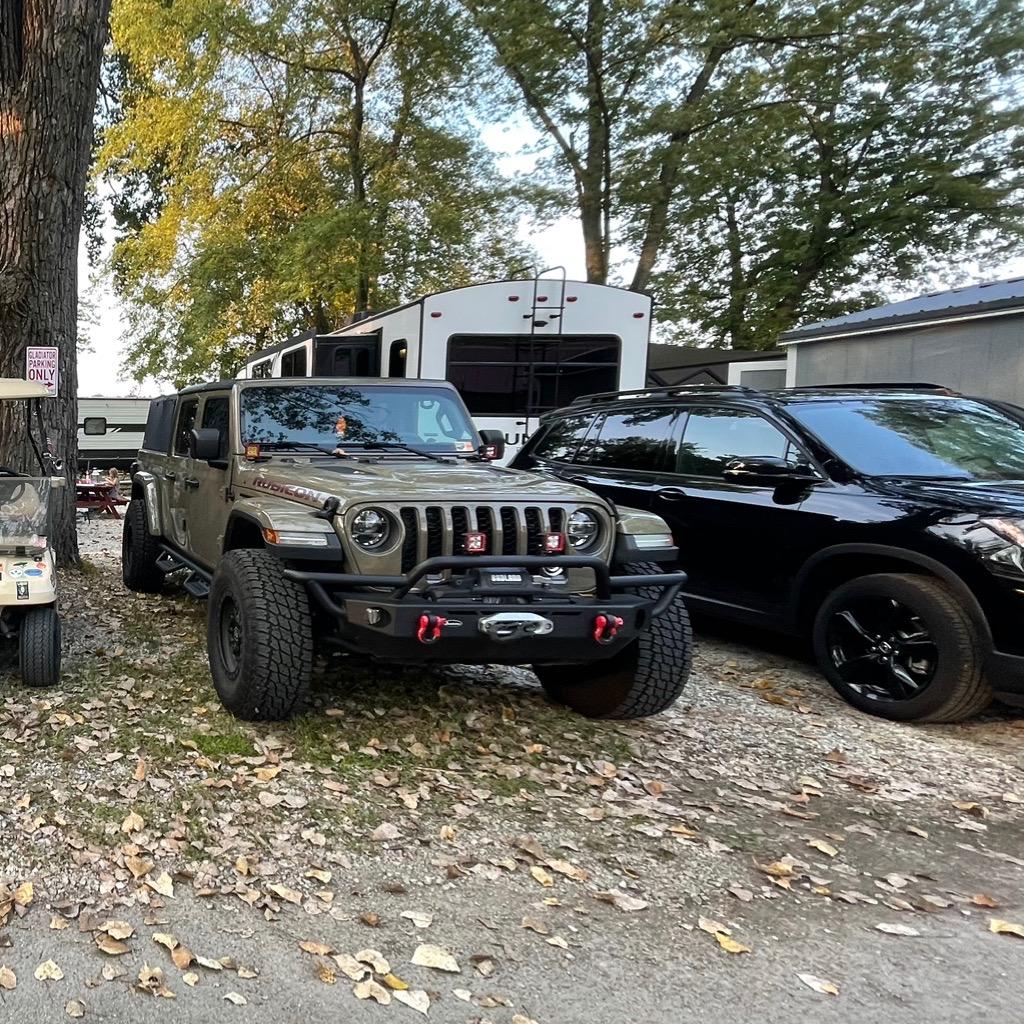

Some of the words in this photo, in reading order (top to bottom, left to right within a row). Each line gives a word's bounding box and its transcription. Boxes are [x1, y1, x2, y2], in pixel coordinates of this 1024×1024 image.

[28, 360, 56, 368] PARKING
[28, 369, 55, 380] ONLY
[253, 476, 321, 503] RUBICON
